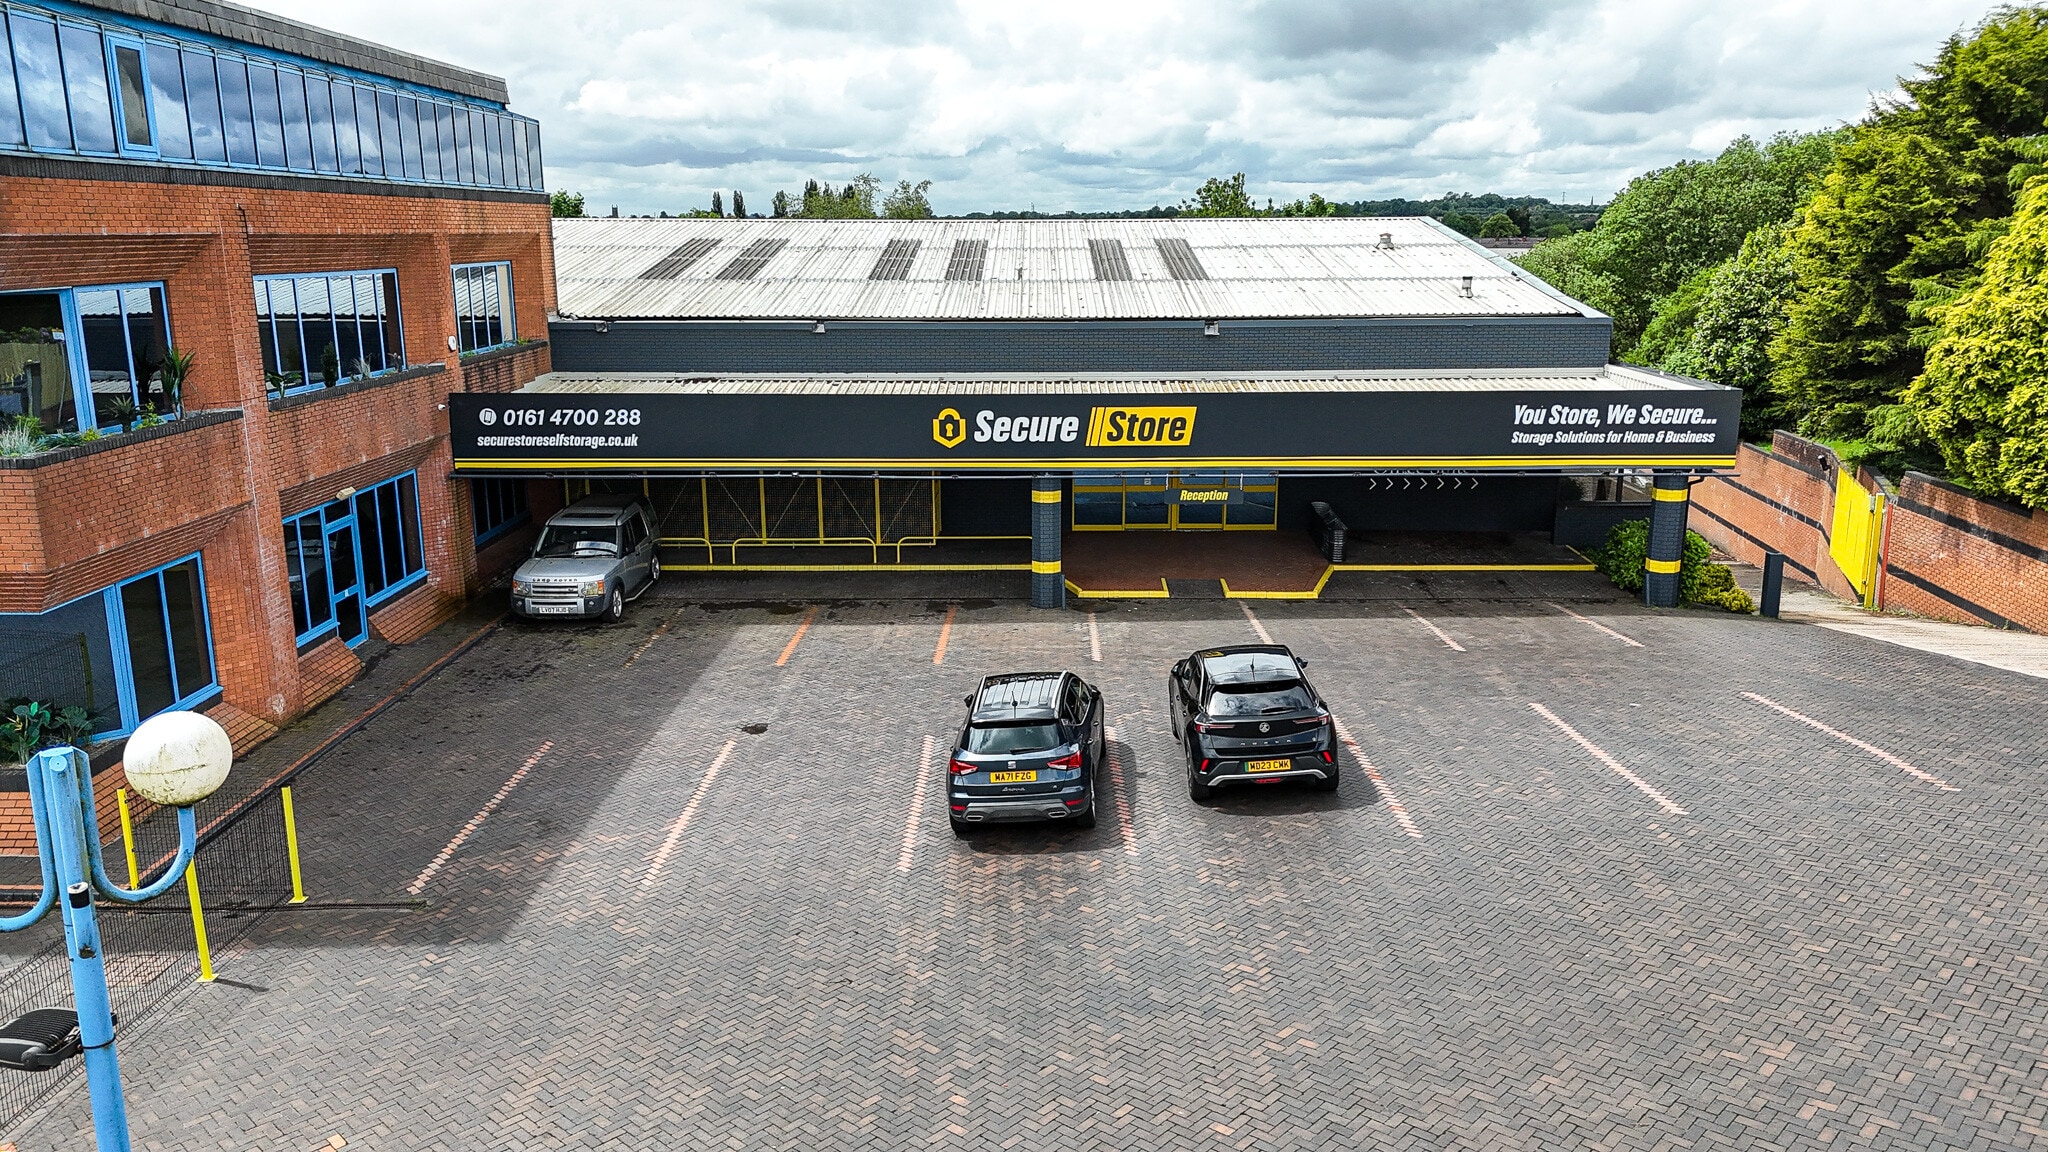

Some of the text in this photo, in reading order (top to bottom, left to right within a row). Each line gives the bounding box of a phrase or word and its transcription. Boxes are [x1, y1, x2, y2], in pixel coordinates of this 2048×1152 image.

[503, 409, 641, 426] 0161 4700 288
[1513, 404, 1718, 428] You Store, We Secure...
[973, 409, 1188, 443] Secure Store
[477, 433, 639, 449] securestoreselfstorage.co.uk
[1511, 431, 1716, 446] Storage Solutions for Home & Business
[1179, 489, 1229, 503] Reception
[1015, 771, 1032, 780] FZG
